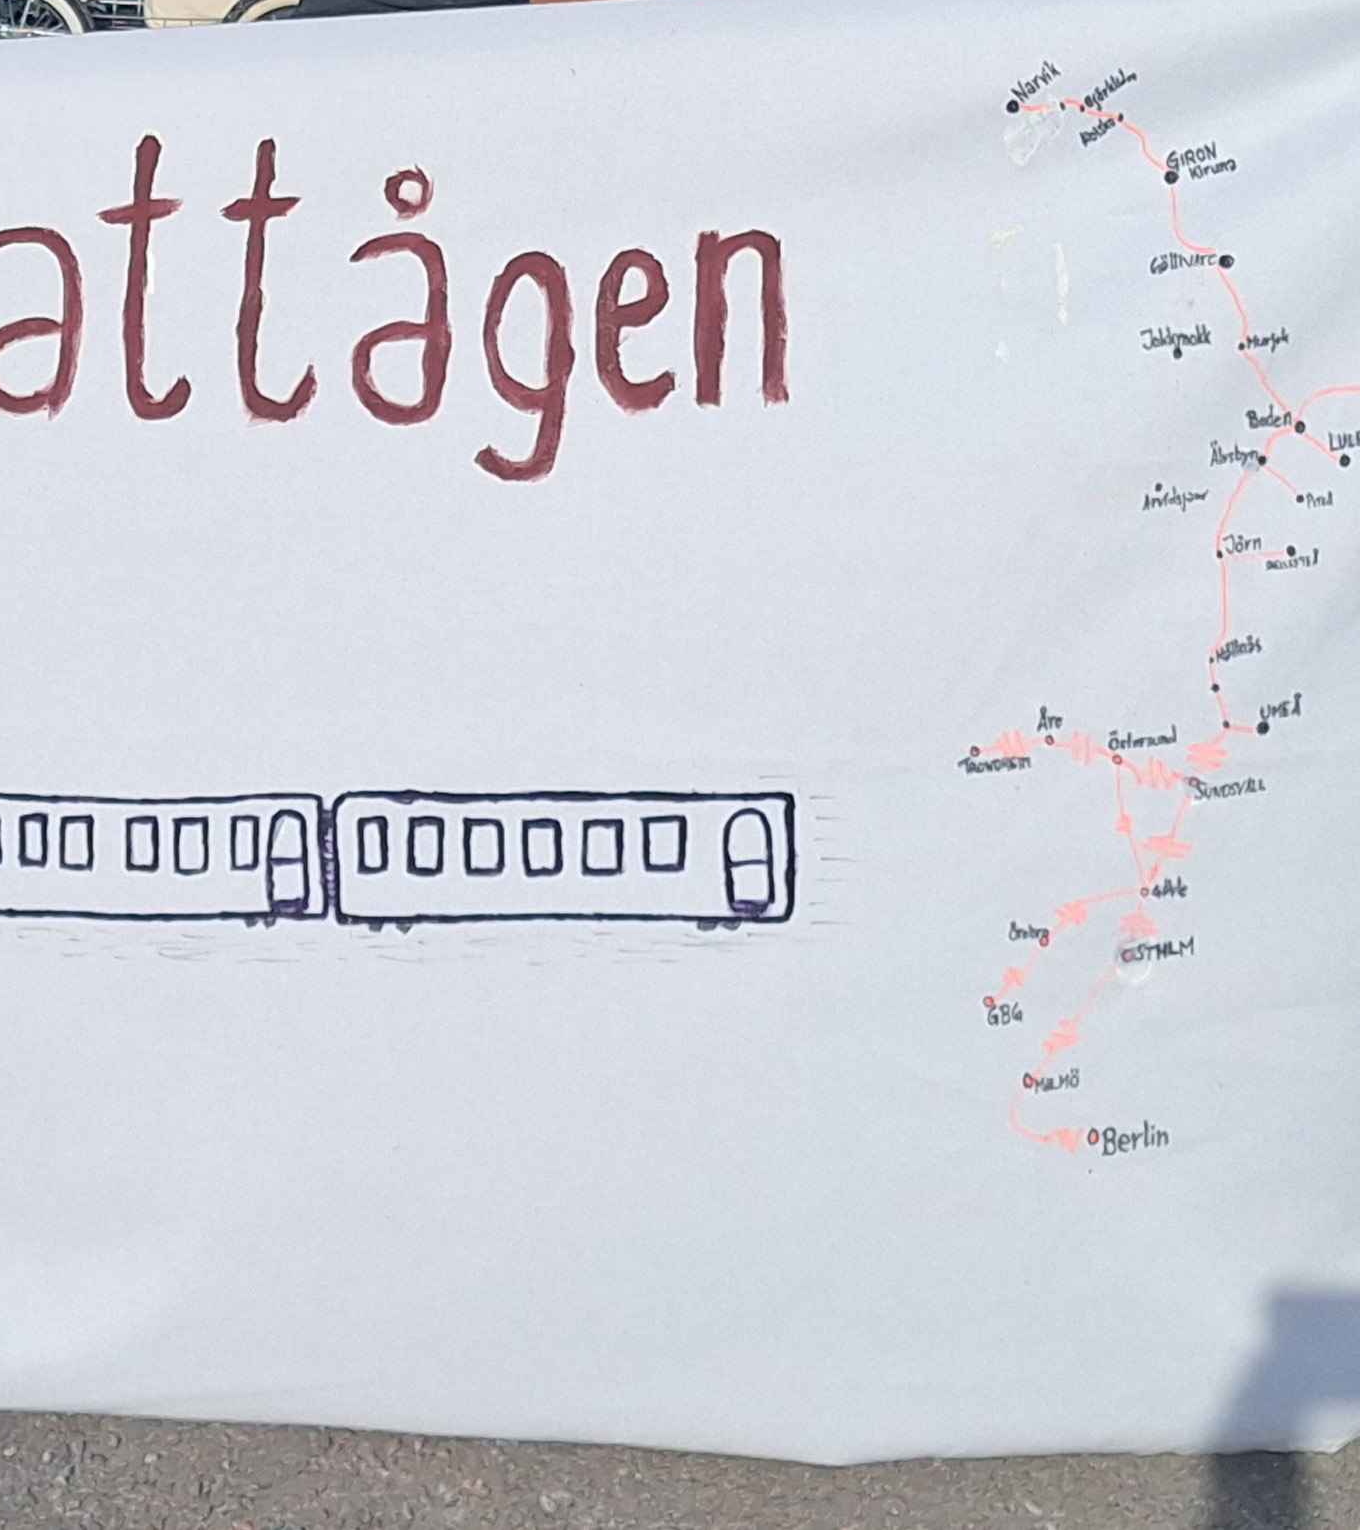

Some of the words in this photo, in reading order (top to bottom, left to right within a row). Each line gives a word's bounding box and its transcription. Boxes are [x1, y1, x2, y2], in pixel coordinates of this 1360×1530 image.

[1011, 60, 1061, 103] Narvik
[1166, 141, 1218, 172] GIRON
[1246, 404, 1292, 428] Boden
[1222, 534, 1261, 555] Jörn
[1037, 706, 1063, 732] Åre
[1259, 692, 1302, 722] UMEÅ
[1133, 936, 1195, 962] STHLM
[986, 1002, 1023, 1026] GBG
[1101, 1120, 1169, 1155] Berlin
